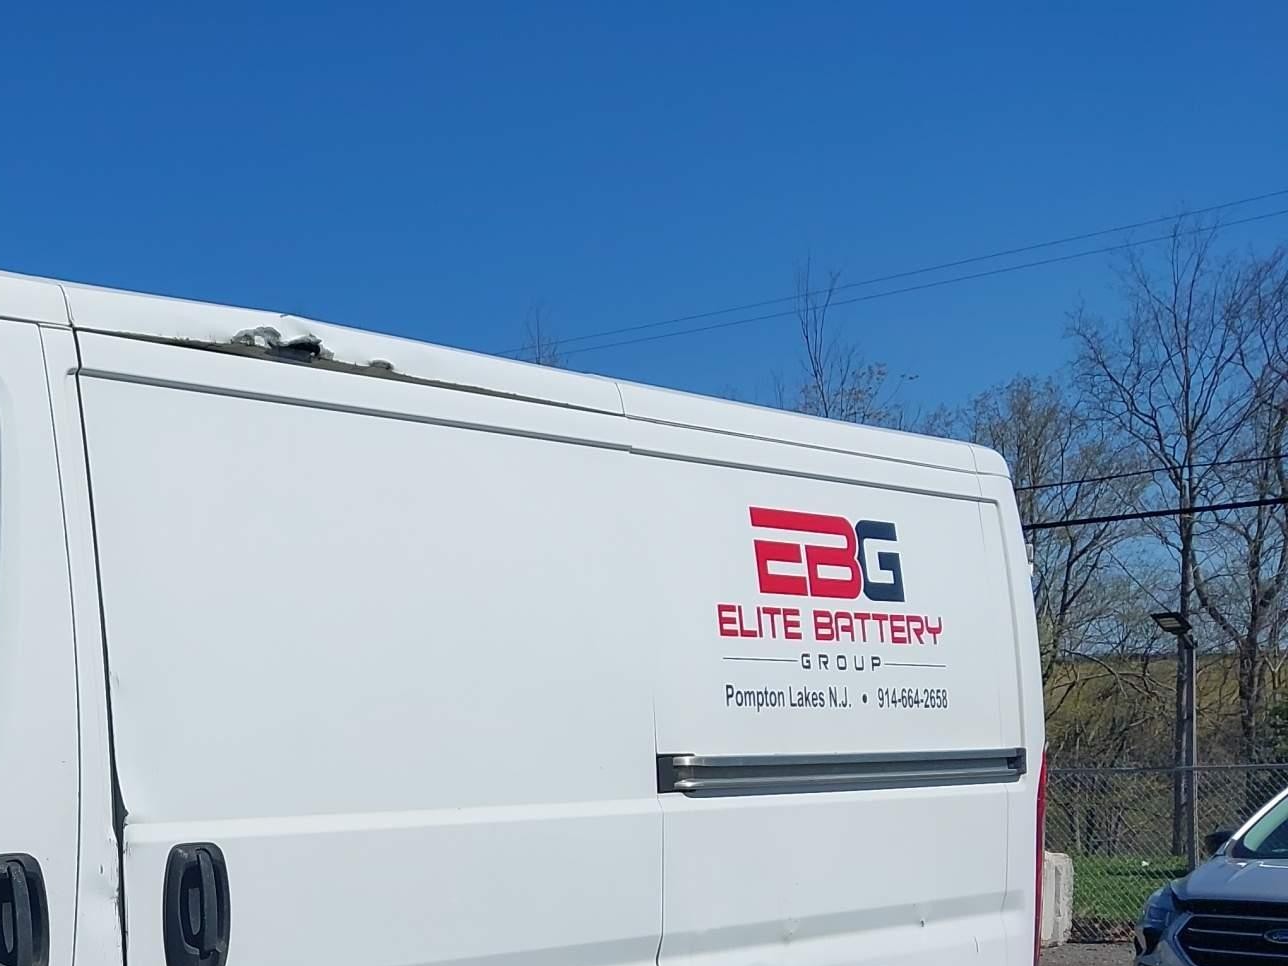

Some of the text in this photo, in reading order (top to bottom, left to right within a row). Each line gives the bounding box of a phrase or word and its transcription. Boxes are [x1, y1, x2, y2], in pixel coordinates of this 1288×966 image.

[749, 506, 905, 602] EBG
[717, 604, 943, 645] ELITE BATTERY
[801, 653, 881, 671] GROUP
[725, 684, 948, 712] Pompton Lakes N.J. 914-664-2658
